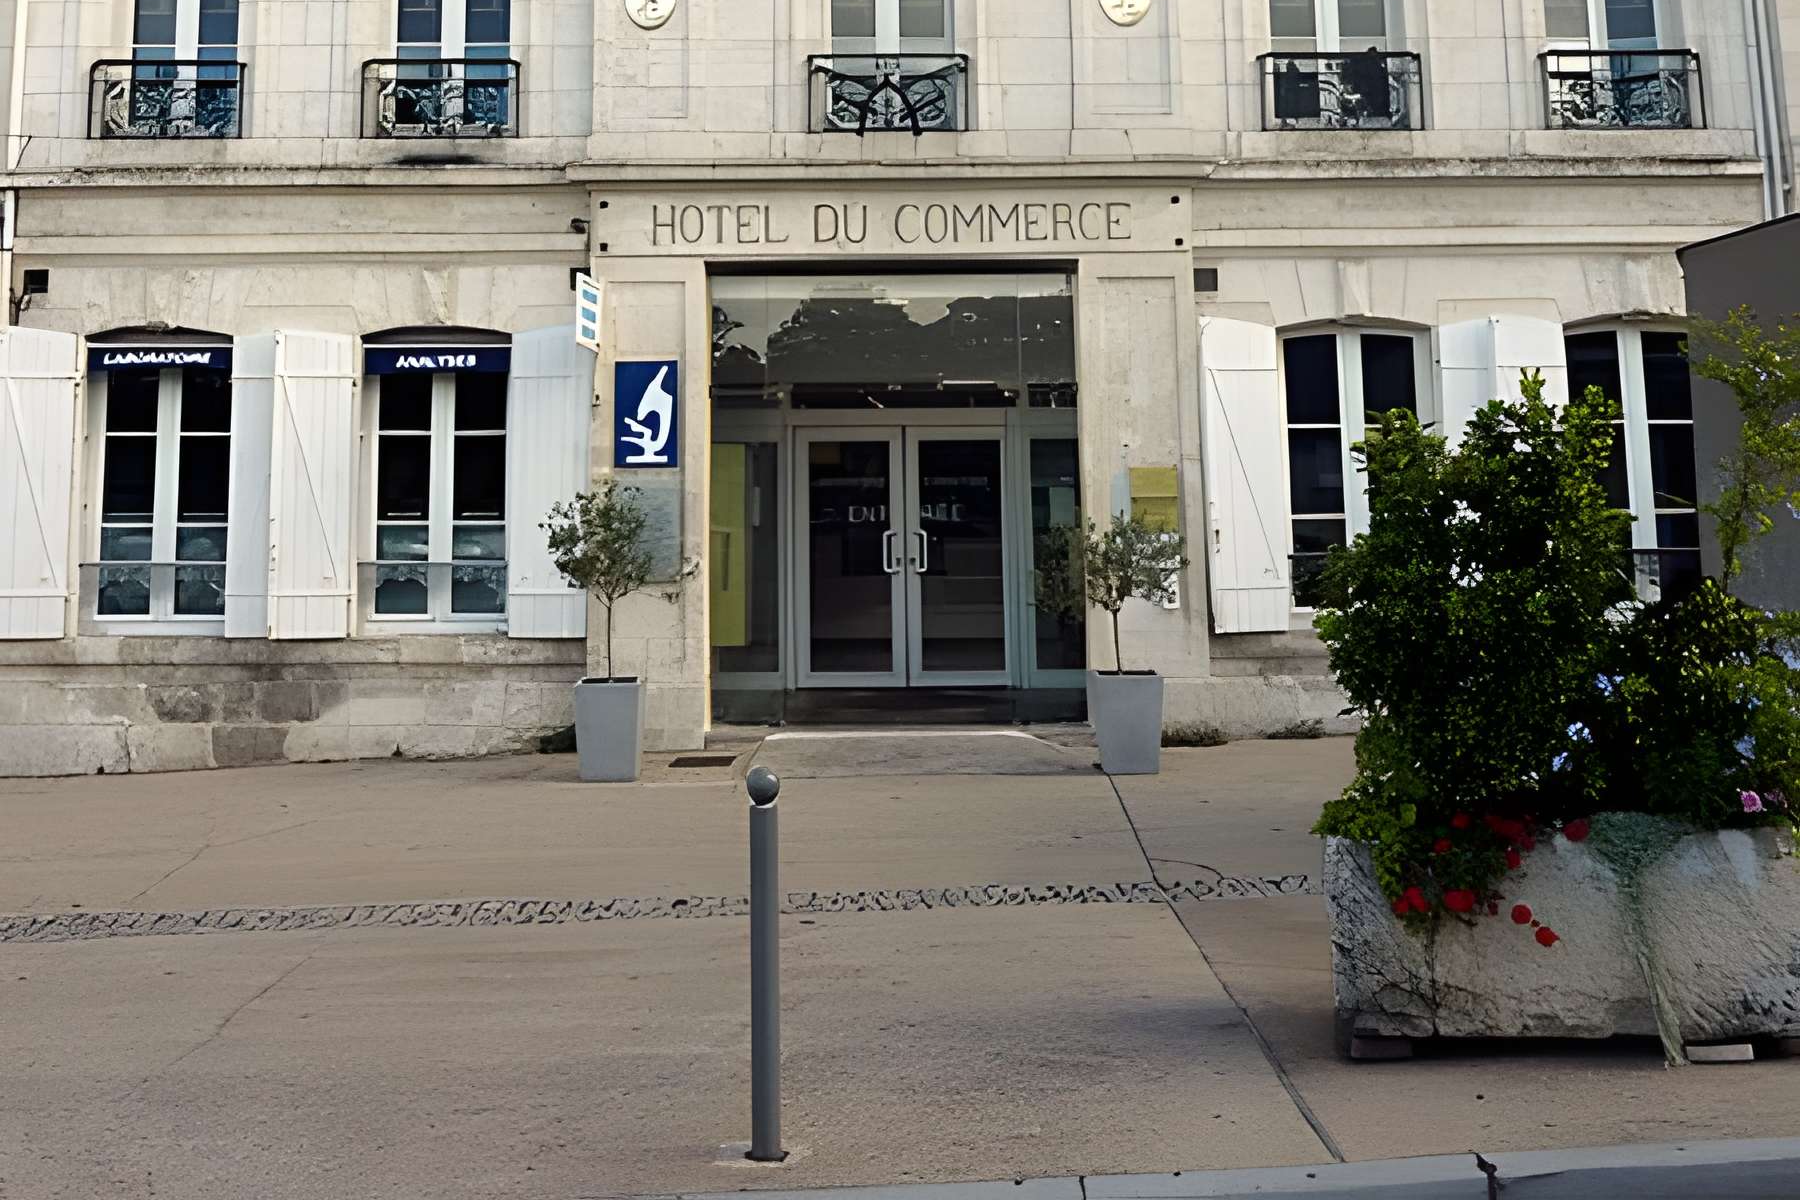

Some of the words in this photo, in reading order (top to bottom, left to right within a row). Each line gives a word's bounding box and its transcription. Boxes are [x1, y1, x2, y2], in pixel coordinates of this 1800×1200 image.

[652, 204, 790, 246] HOTEL
[813, 203, 868, 244] DU
[894, 202, 1132, 244] COMMERCE
